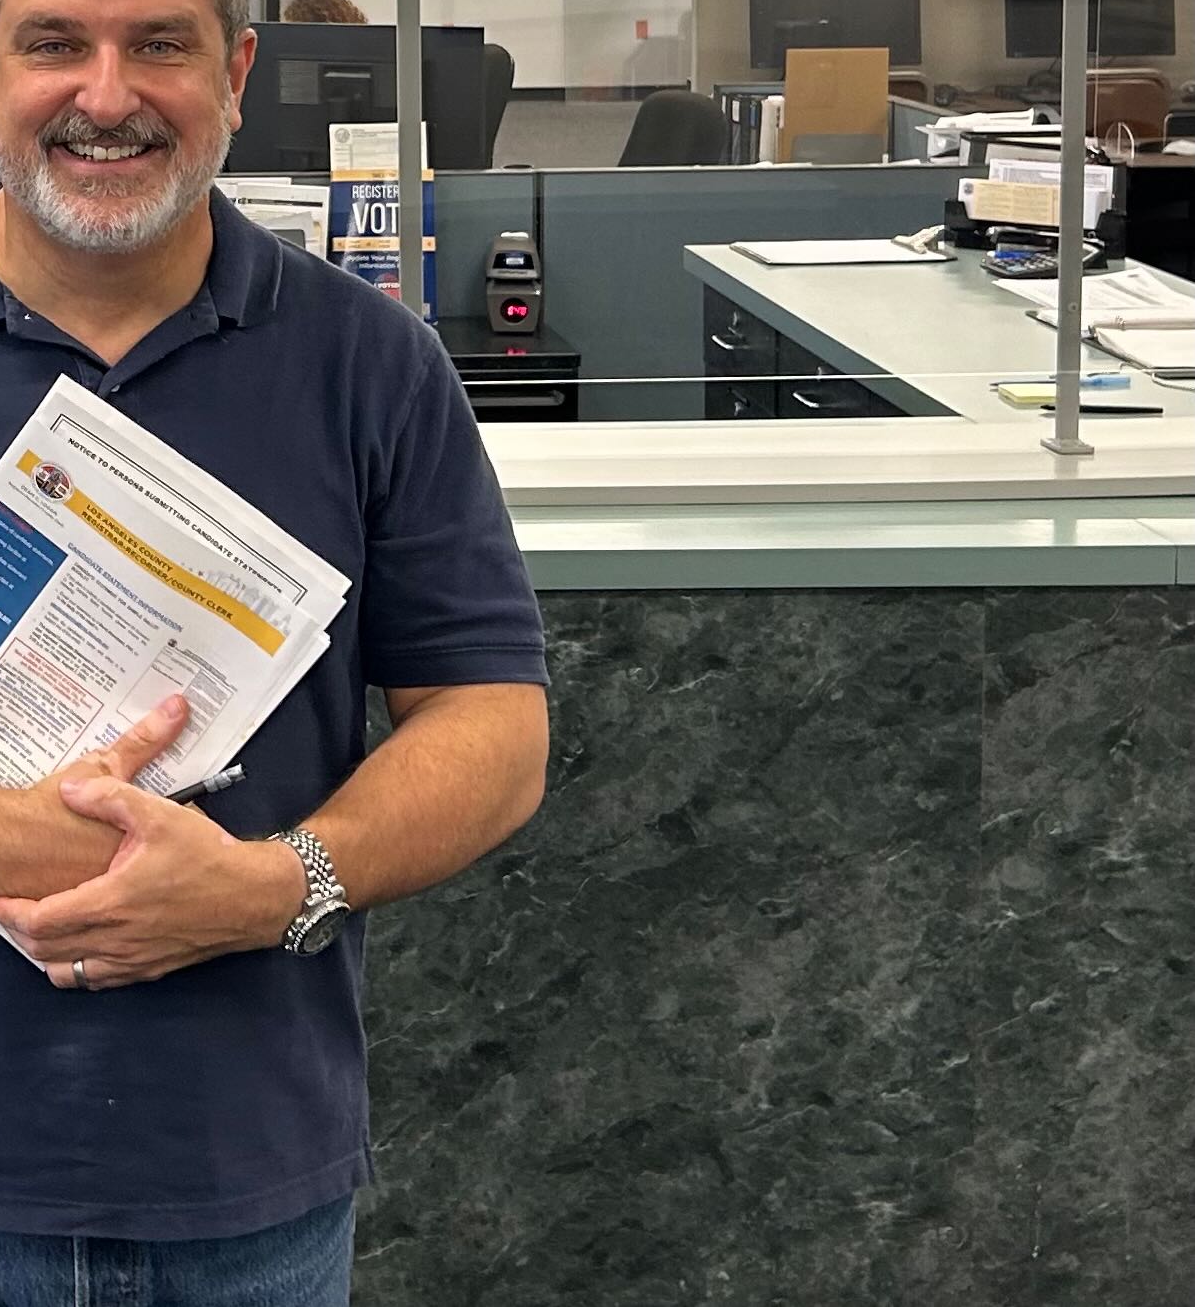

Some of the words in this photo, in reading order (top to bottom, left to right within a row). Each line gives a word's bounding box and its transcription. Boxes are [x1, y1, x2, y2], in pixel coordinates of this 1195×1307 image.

[352, 202, 400, 234] VOT
[67, 437, 97, 460] NOTICE
[96, 457, 109, 468] TO
[107, 465, 145, 493] PERSONS
[143, 489, 191, 526] SUBMITTING
[190, 523, 233, 558] CANDIDATE
[85, 504, 102, 520] LOS
[101, 517, 139, 549] ANGELES
[137, 545, 173, 573] COUNTY
[205, 599, 233, 620] CLERK
